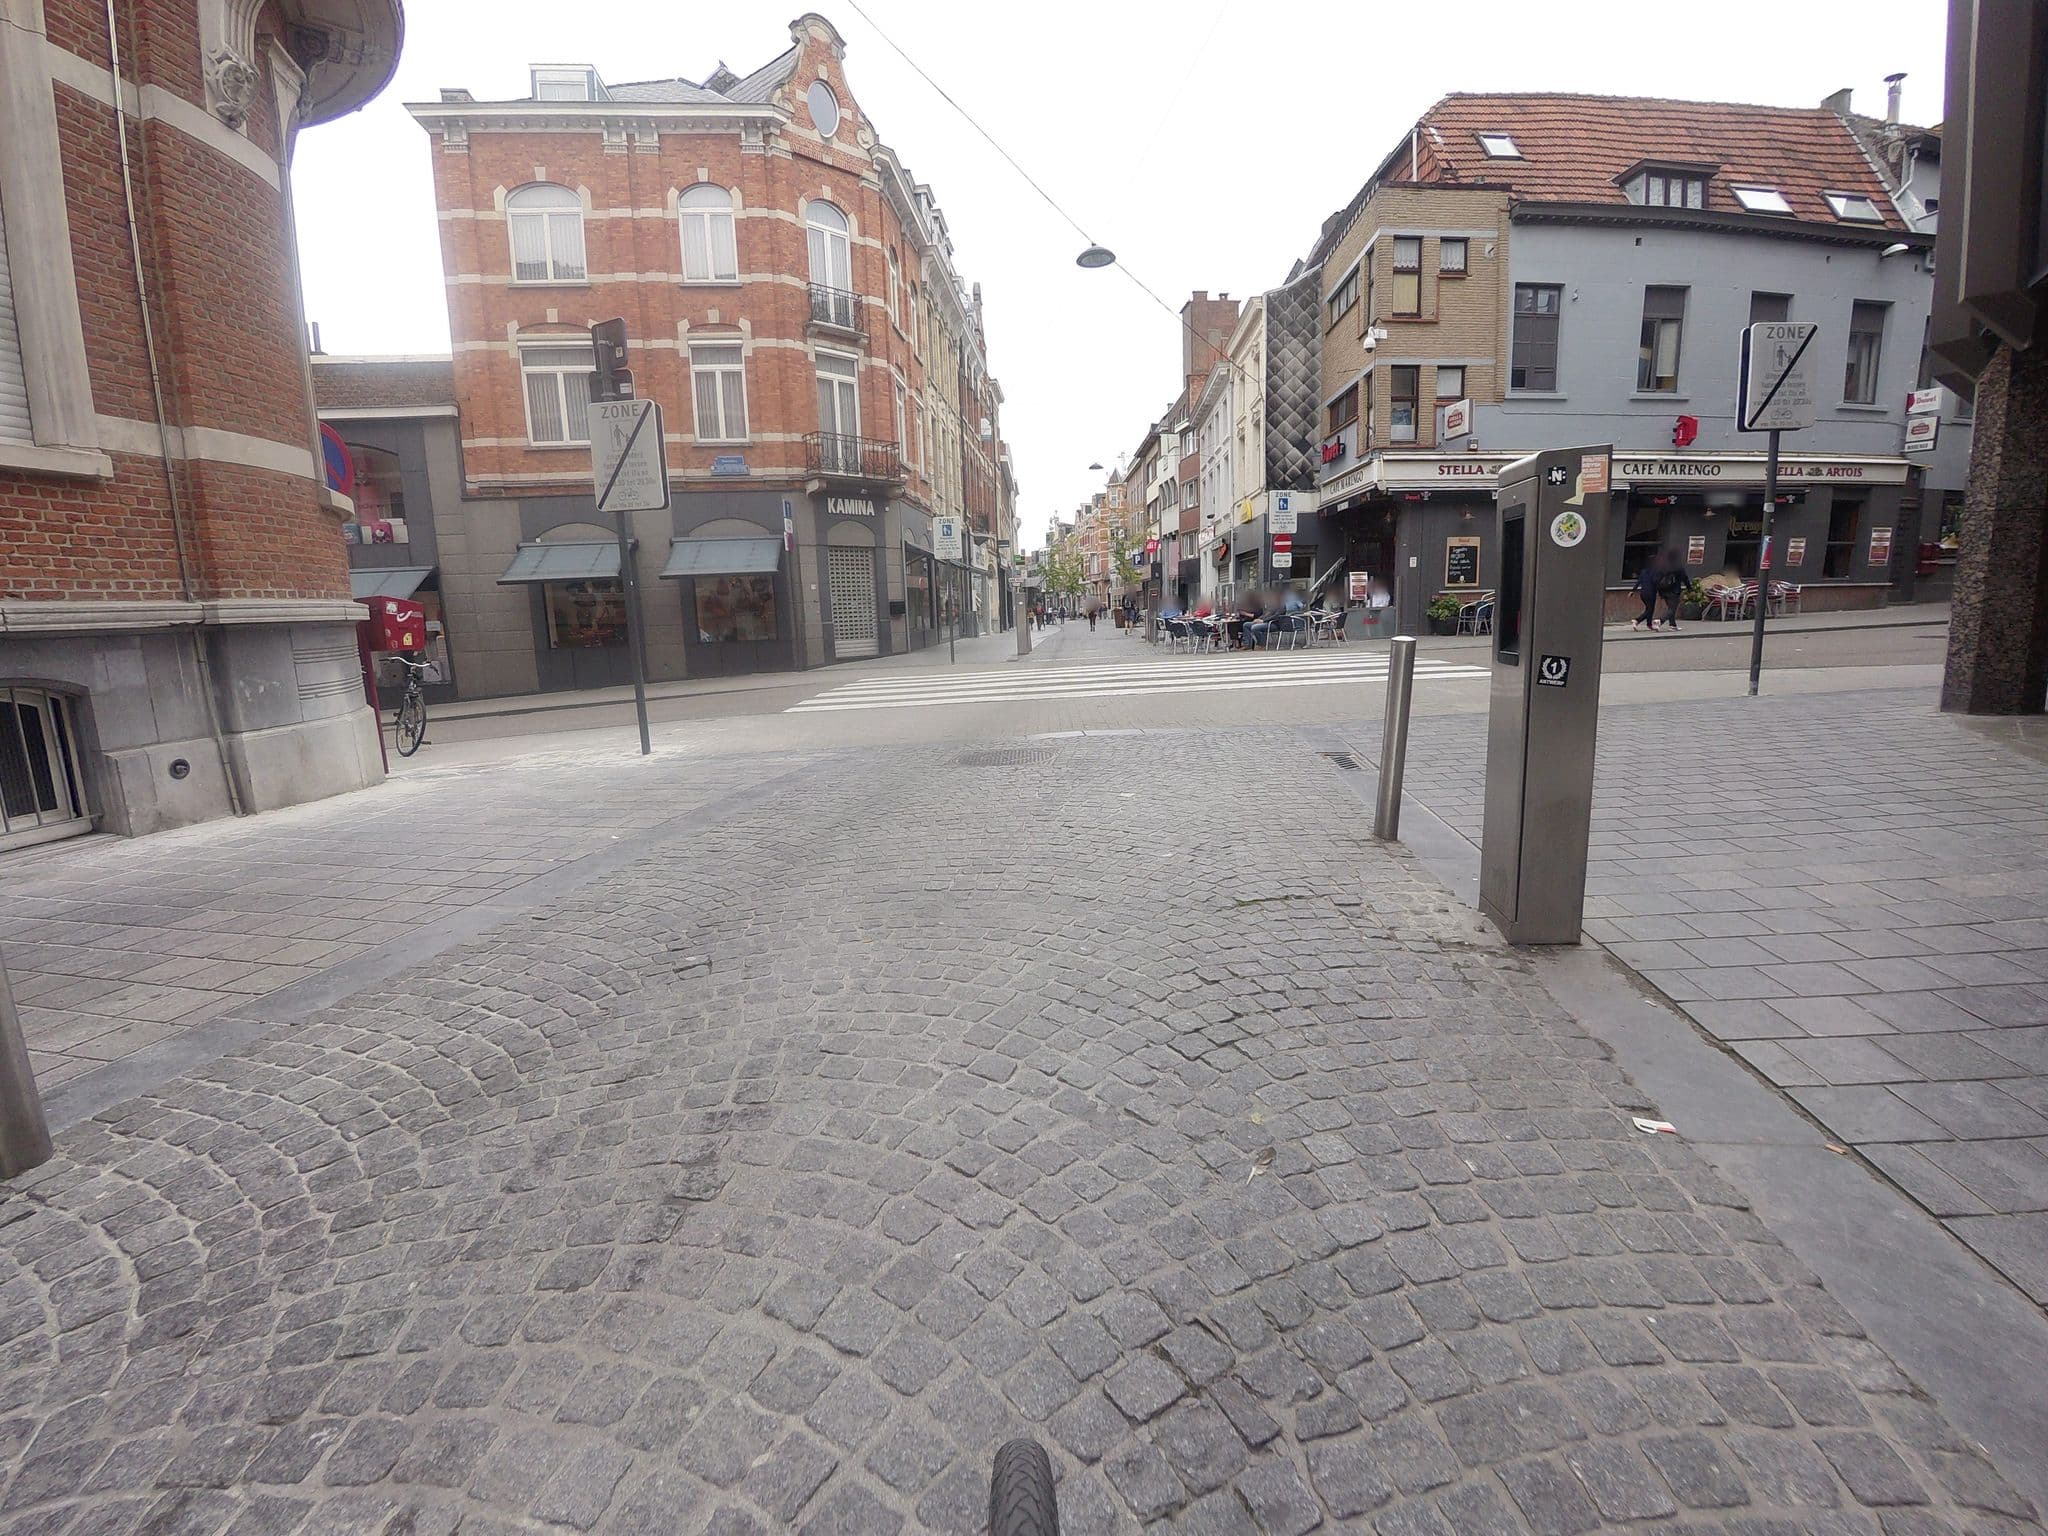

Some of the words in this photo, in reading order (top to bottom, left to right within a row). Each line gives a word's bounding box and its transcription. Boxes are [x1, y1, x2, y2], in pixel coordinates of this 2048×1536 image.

[1766, 326, 1806, 339] ZONE
[600, 403, 641, 419] ZONE
[1438, 465, 1485, 475] STELLA
[1622, 463, 1655, 476] CAFE
[1657, 463, 1722, 477] MARENGO
[1825, 466, 1864, 478] ARTOIS
[1340, 470, 1364, 490] MARENGO
[827, 496, 876, 516] KAMINA
[1550, 662, 1558, 674] 1
